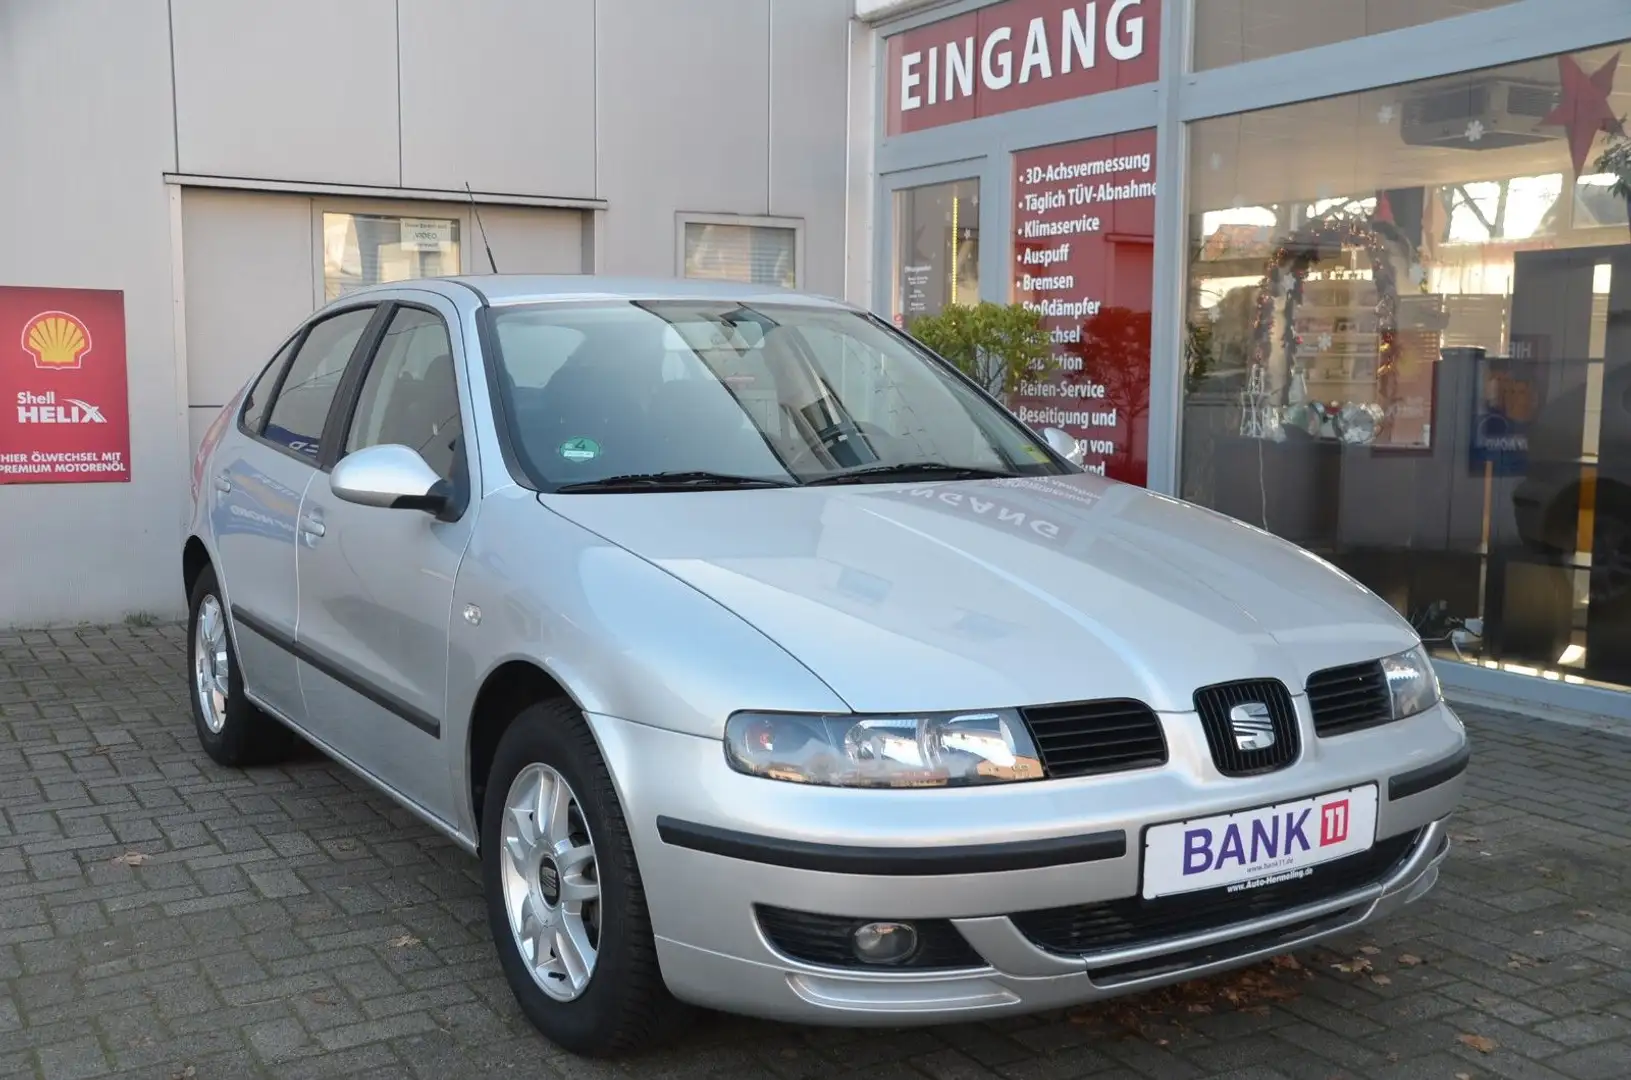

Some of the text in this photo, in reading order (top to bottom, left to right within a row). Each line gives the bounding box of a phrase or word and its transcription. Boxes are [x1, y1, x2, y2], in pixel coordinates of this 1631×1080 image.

[900, 0, 1145, 112] EINGANG
[1025, 153, 1151, 185] 3D-Achsvermessung
[1024, 189, 1066, 214] Täglich
[1024, 214, 1100, 239] Klimaservice
[1023, 243, 1070, 267] Auspuff
[1022, 274, 1074, 291] Bremsen
[17, 391, 56, 405] Shell
[17, 399, 108, 424] HELIX
[1019, 405, 1117, 429] Beseitigung und
[31, 450, 98, 463] ÖLWECHSEL
[101, 452, 121, 462] MIT
[1090, 439, 1114, 455] von
[54, 458, 126, 473] MOTORENÖL
[1182, 807, 1313, 877] BANK
